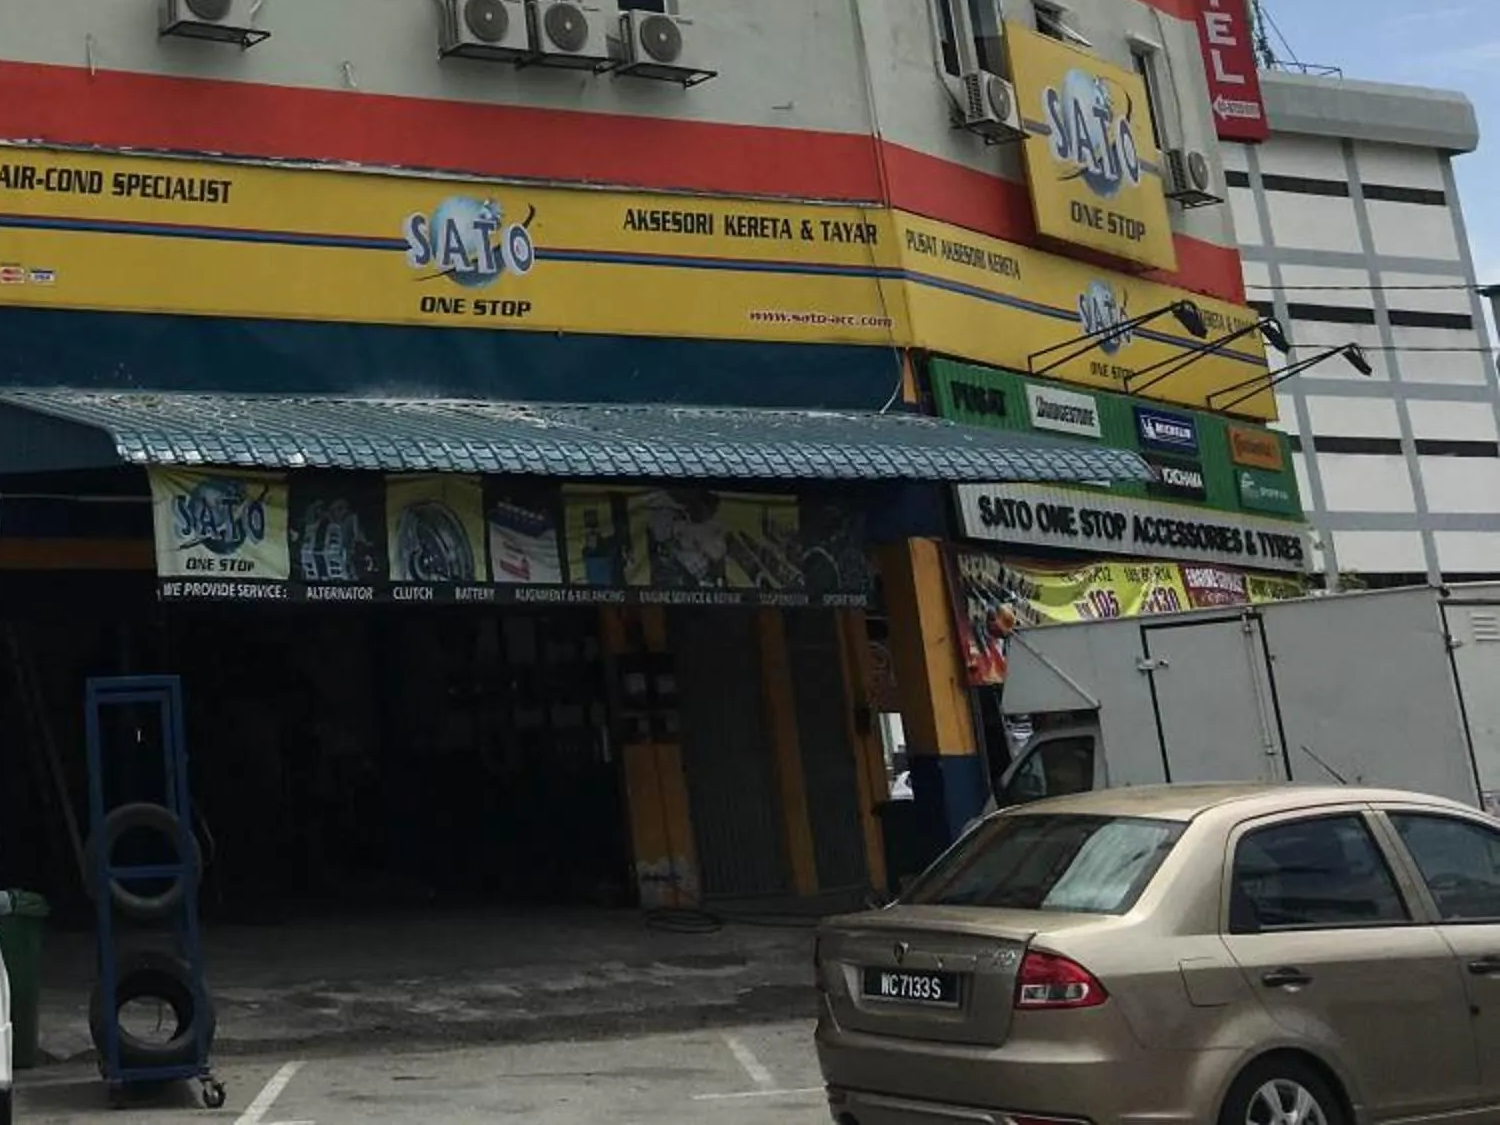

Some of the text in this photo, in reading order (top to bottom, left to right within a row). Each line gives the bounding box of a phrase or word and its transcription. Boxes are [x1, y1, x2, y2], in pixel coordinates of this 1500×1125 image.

[1041, 85, 1140, 187] SATO
[111, 172, 233, 205] SPECIALIST
[623, 208, 878, 244] AKSESORI KERETA & TAYAR
[1070, 200, 1147, 243] ONE STOP
[404, 210, 537, 276] SATO
[905, 227, 938, 257] PUSAT
[420, 295, 532, 318] ONE STOP
[749, 310, 894, 329] www.sato-acc.com
[1088, 361, 1109, 379] ONE
[172, 494, 267, 546] SATO
[977, 494, 1033, 531] SATO
[1035, 501, 1078, 537] ONE
[1079, 507, 1128, 542] STOP
[1131, 514, 1243, 556] ACCESSORIES
[1257, 531, 1304, 562] TYRES
[185, 556, 255, 573] ONE STOP
[184, 582, 236, 598] PROVIDE
[305, 586, 374, 601] ALTERNATOR
[392, 586, 434, 601] CLUTCH
